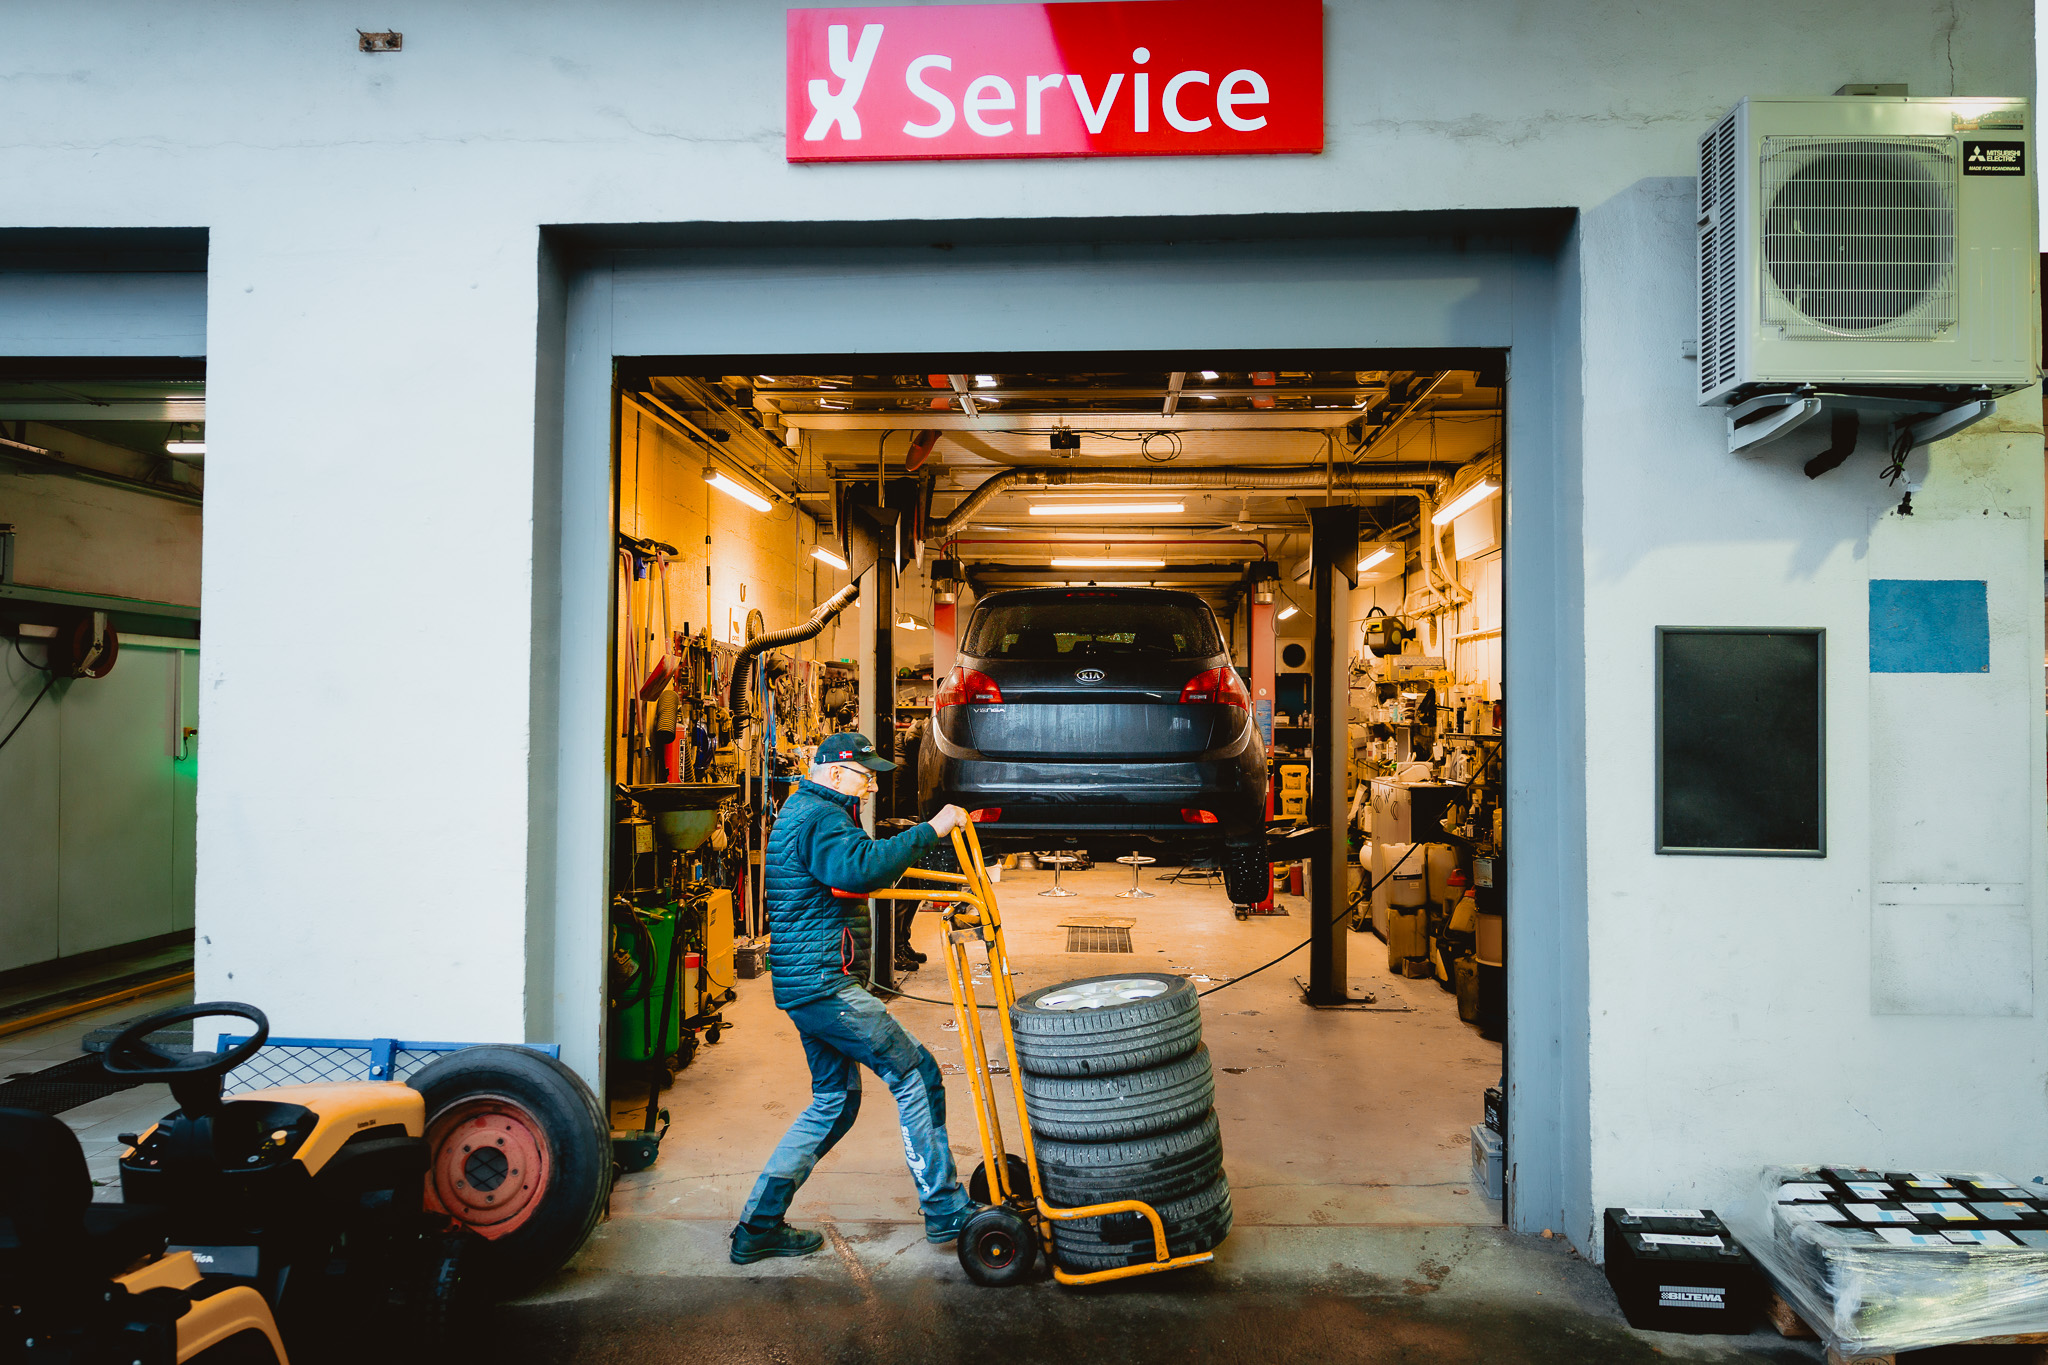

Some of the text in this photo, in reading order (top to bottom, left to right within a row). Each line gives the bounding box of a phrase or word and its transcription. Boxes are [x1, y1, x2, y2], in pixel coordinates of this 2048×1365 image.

[903, 46, 1270, 139] Service
[901, 1125, 916, 1160] SUPER
[191, 1254, 214, 1263] TIGA
[1668, 1292, 1722, 1303] BILTEMA
